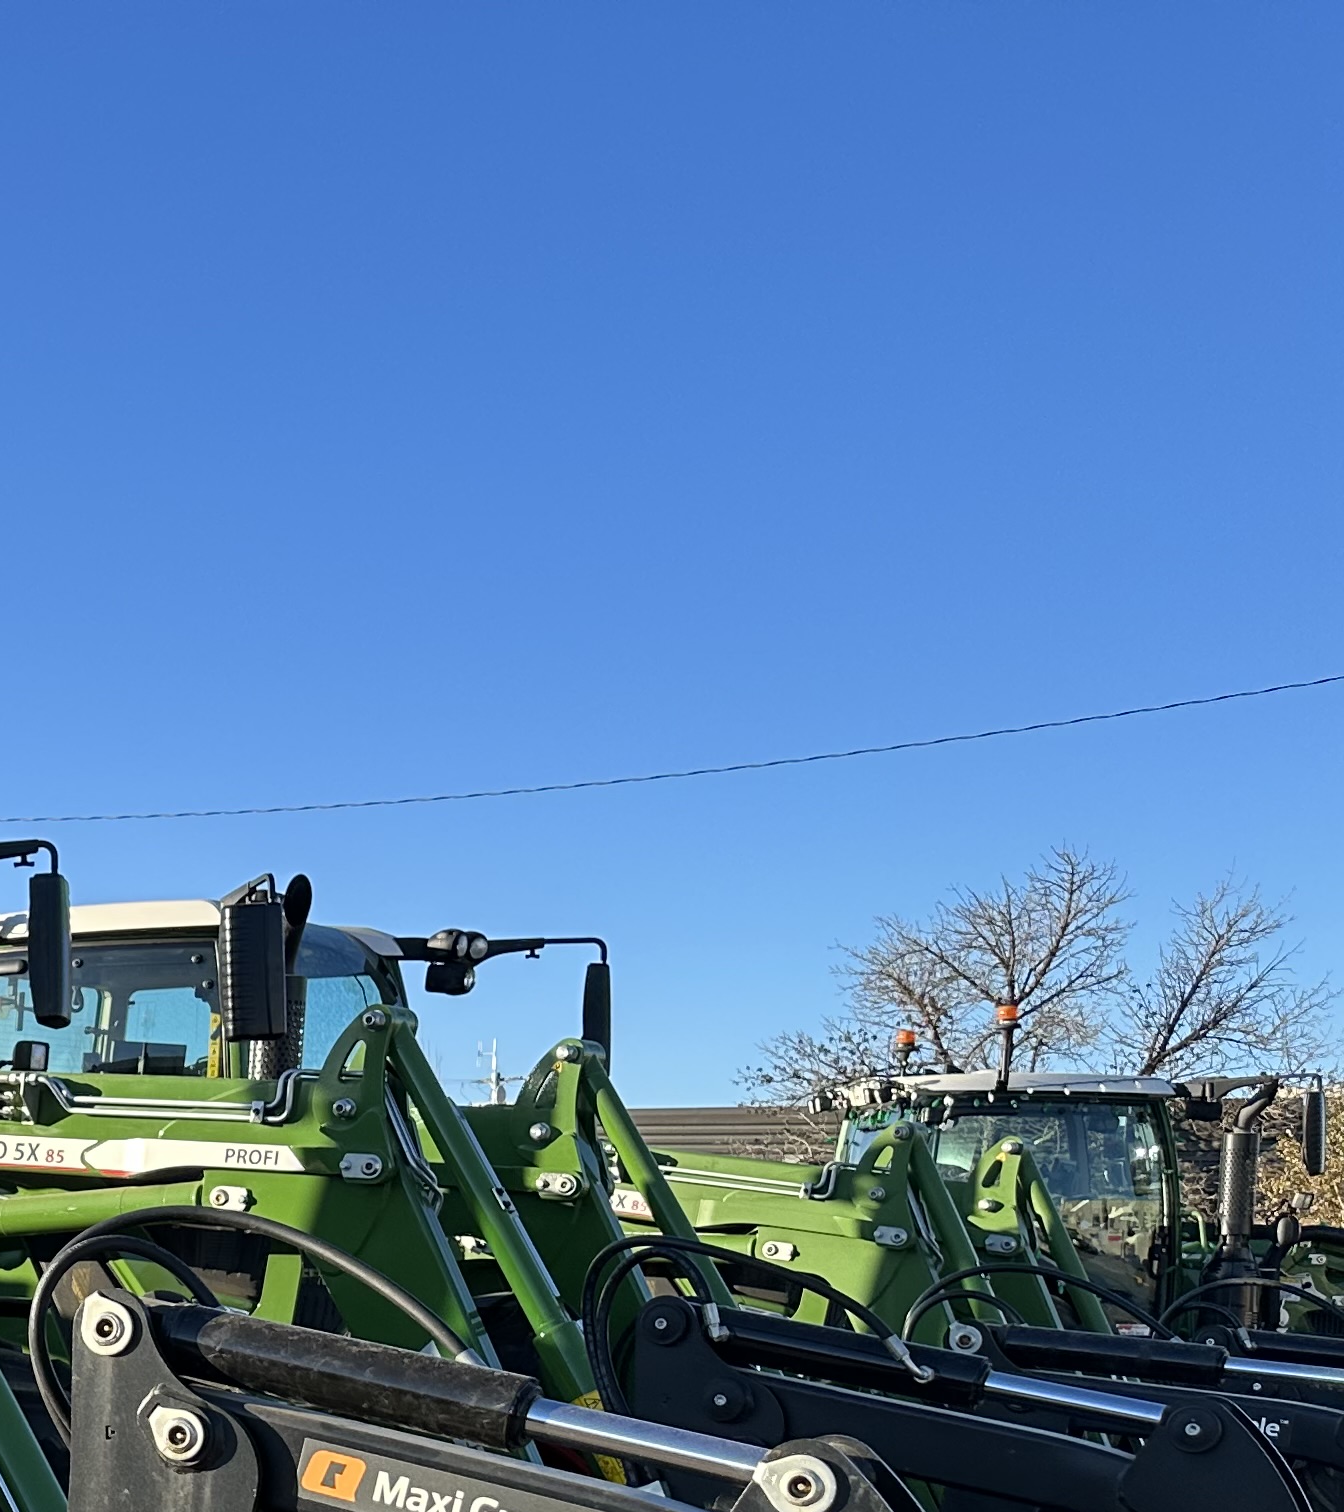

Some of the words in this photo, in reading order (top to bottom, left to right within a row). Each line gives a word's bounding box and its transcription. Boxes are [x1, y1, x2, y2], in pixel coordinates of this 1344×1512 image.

[13, 1141, 40, 1163] 5X
[44, 1148, 65, 1164] 85
[224, 1148, 280, 1166] PROFI
